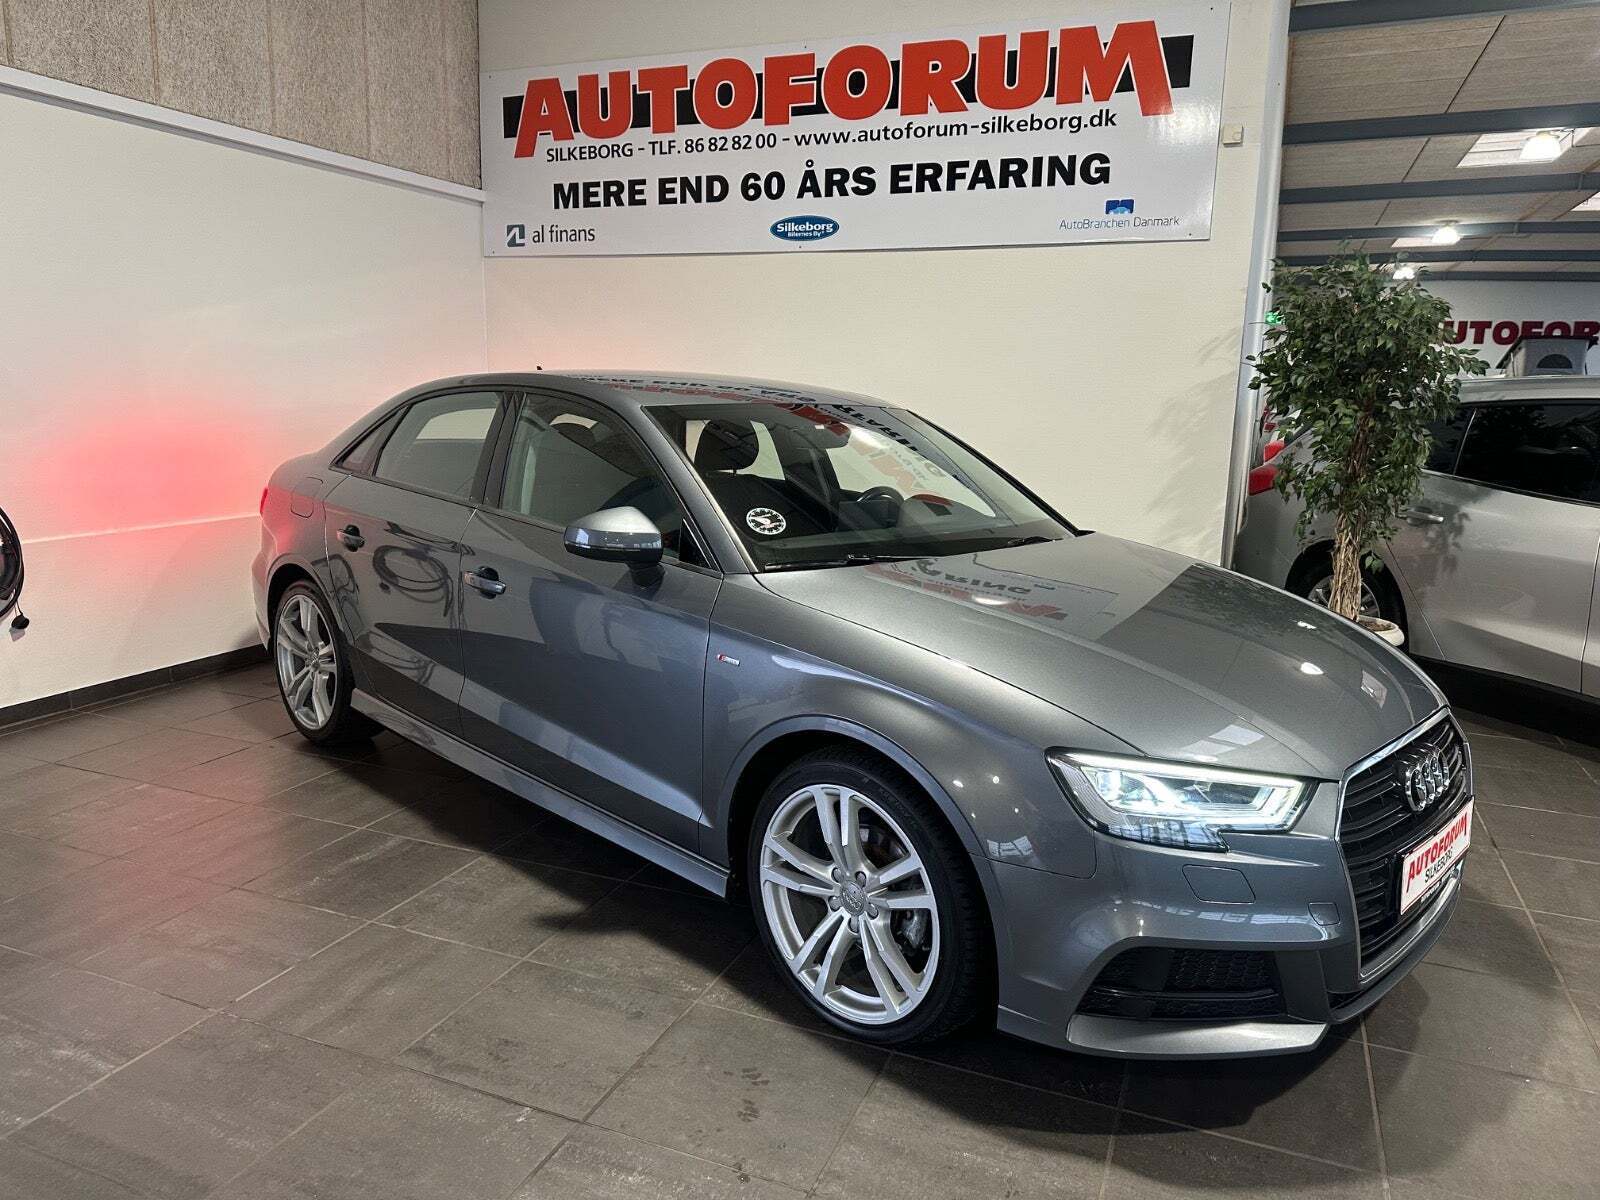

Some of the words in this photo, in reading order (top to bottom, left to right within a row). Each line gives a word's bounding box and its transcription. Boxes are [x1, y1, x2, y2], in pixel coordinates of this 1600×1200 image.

[513, 20, 1175, 159] AUTOFORUM
[546, 143, 634, 162] SILKEBORG
[648, 139, 681, 156] TLF.
[793, 108, 1118, 146] www.autoforum-silkeborg.dk
[553, 178, 647, 210] MERE
[658, 174, 730, 205] END
[740, 170, 786, 201] 60
[796, 159, 877, 199] ÅRS
[889, 152, 1111, 194] ERFARING
[532, 224, 545, 244] al
[548, 224, 596, 243] finans
[776, 221, 835, 233] Silkeborg
[1059, 217, 1130, 231] AutoBranchen
[1133, 216, 1181, 228] Danmark
[1442, 319, 1600, 346] UTOFOR
[1405, 811, 1468, 894] AUTOFORUM
